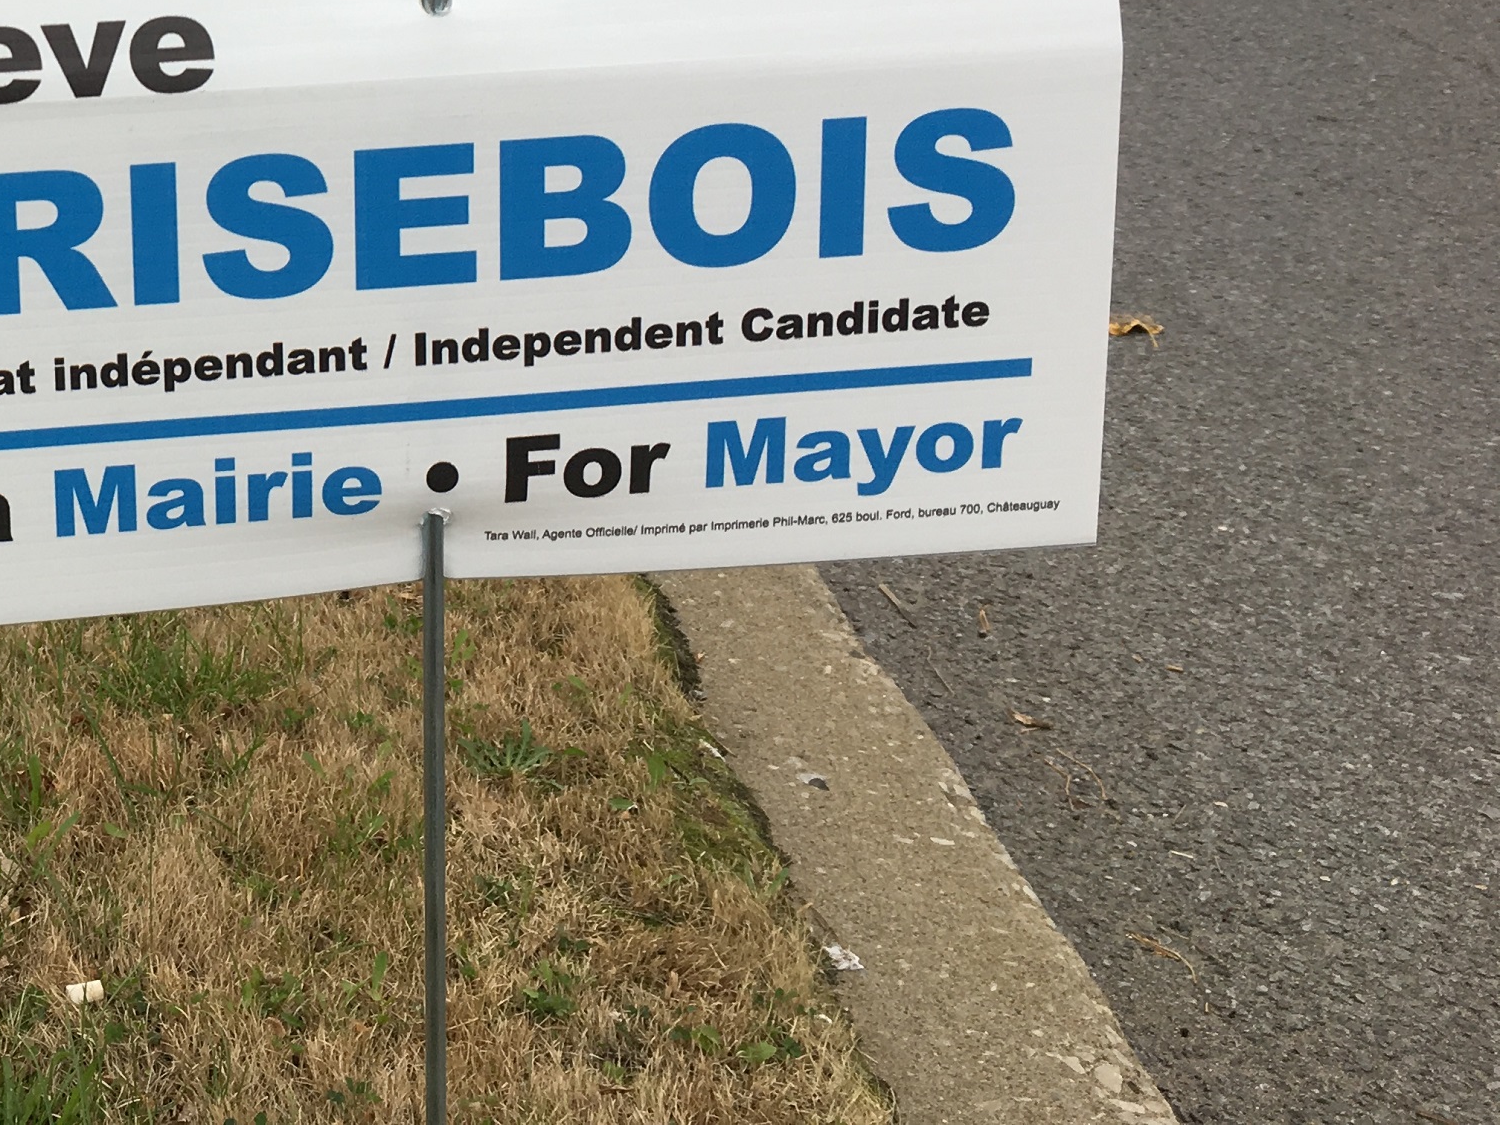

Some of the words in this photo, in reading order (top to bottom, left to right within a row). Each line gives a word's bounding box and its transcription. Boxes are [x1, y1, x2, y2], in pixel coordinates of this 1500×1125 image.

[54, 341, 368, 393] indépendant
[414, 311, 724, 368] Independent
[741, 295, 990, 343] Candidate
[53, 451, 383, 538] Mairie
[504, 433, 672, 504] For
[705, 416, 1023, 497] Mayor
[484, 530, 509, 542] Tara
[541, 528, 583, 542] Agente
[640, 522, 686, 537] Imprimé
[688, 522, 709, 535] par
[710, 517, 770, 533] Imprimerie
[772, 514, 829, 528] Phil-Marc,
[831, 511, 853, 524] 625
[855, 509, 883, 522] boul.
[885, 508, 915, 521] Ford,
[917, 505, 957, 518] bureau
[959, 503, 984, 516] 700,
[986, 498, 1061, 515] Châteauguay
